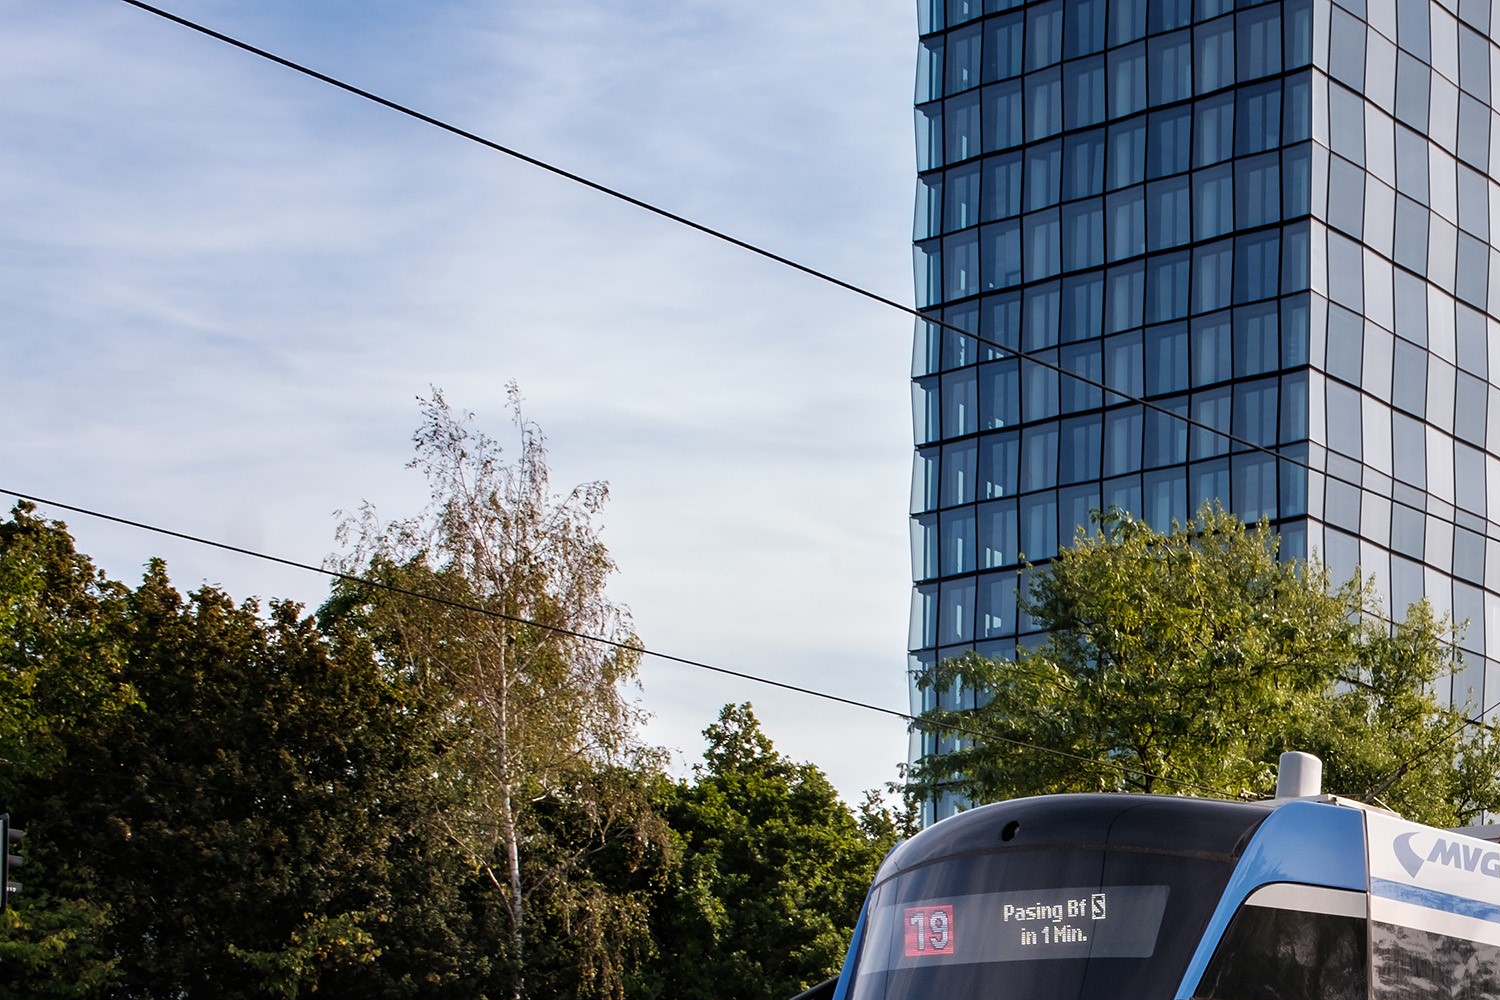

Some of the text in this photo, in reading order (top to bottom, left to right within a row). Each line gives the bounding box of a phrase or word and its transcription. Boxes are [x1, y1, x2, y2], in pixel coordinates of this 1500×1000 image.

[1003, 901, 1063, 922] Pasing
[1067, 899, 1087, 918] Bf
[910, 911, 948, 950] 19
[1021, 925, 1088, 945] in 1 Min.
